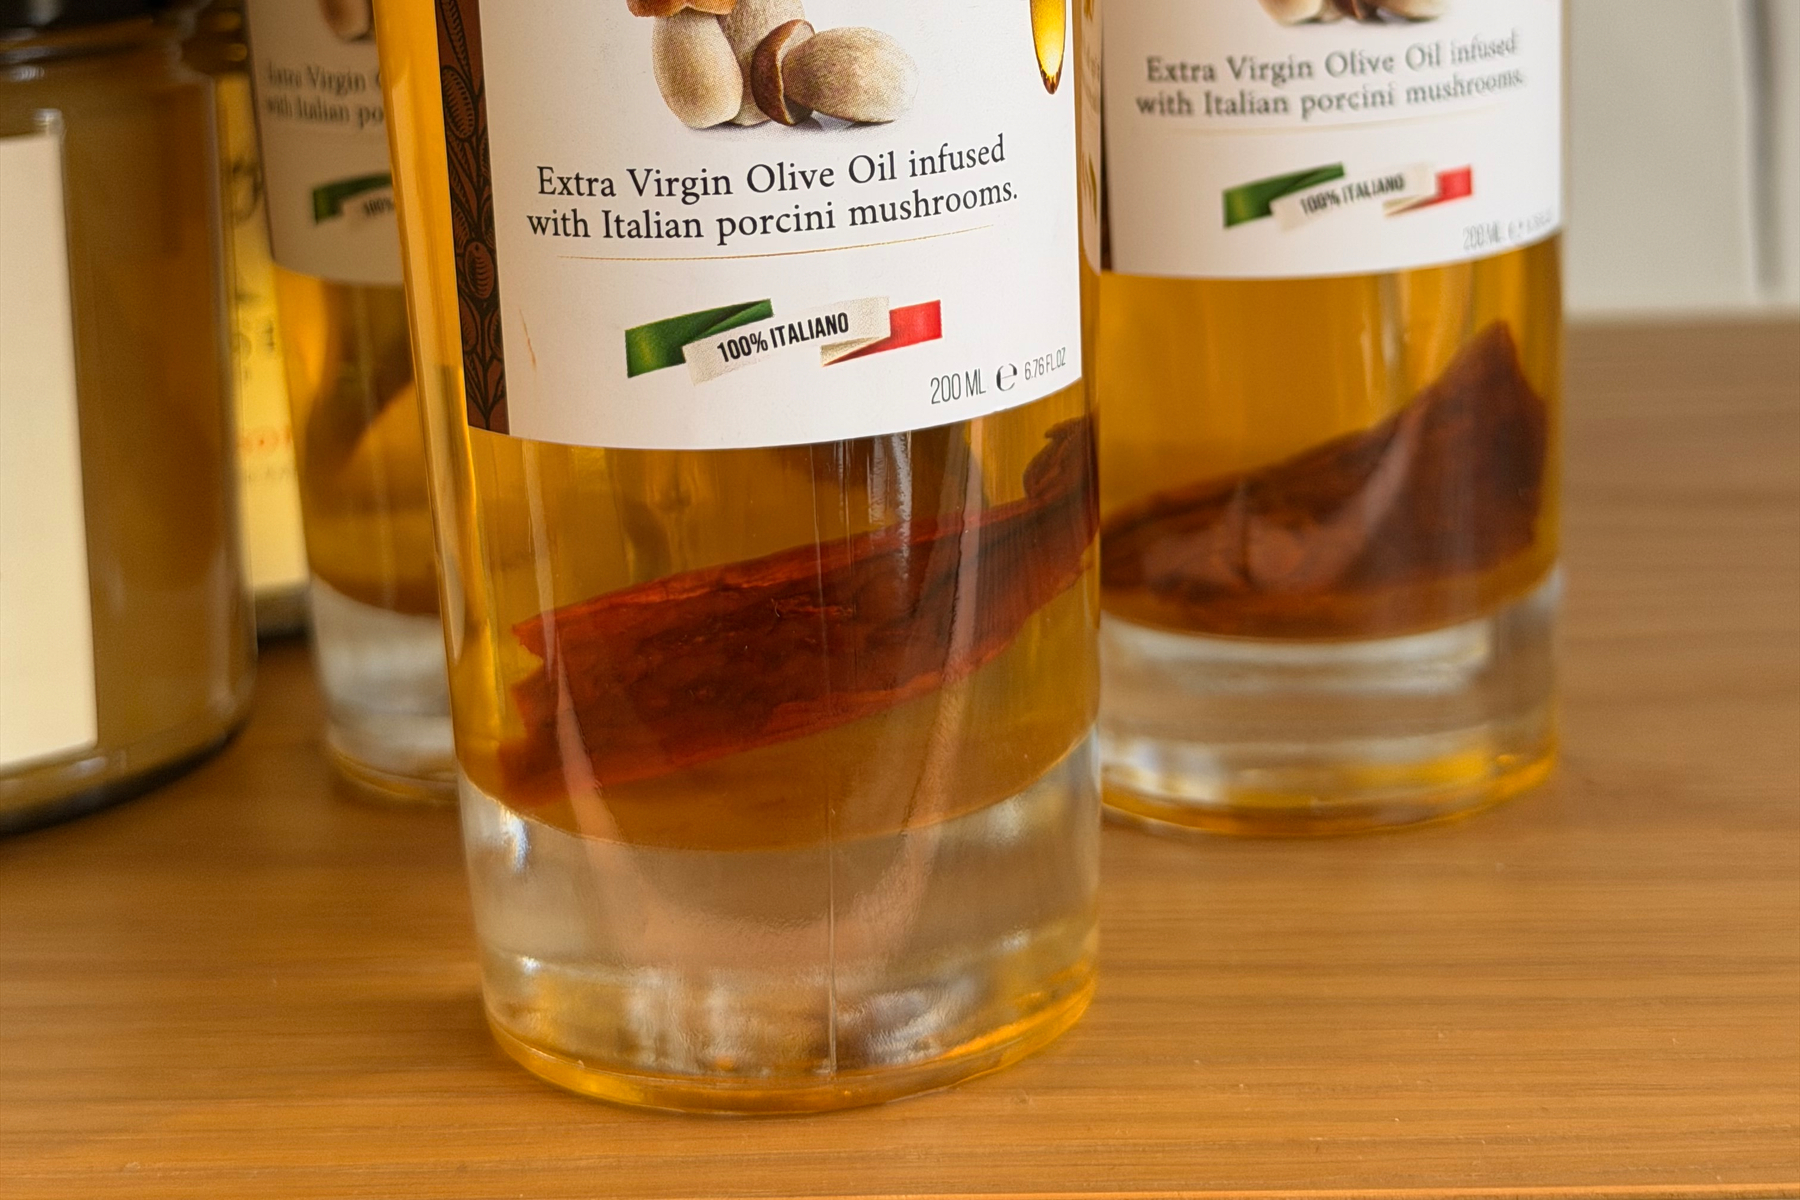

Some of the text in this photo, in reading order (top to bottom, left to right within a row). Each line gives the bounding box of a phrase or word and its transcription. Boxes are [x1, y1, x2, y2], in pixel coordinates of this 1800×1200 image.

[1147, 28, 1517, 87] Extra Virgin Olive Oil infused
[1135, 69, 1524, 120] with Italian porcini mushrooms.
[536, 133, 1007, 205] Extra Virgin Olive Oil infused
[1341, 172, 1405, 205] ITALIANO
[526, 177, 1019, 246] with Italian porcini mushrooms.
[717, 311, 850, 363] 100% ITALIANO
[929, 372, 962, 405] 200
[965, 367, 987, 398] ML
[1024, 356, 1045, 381] 6.76
